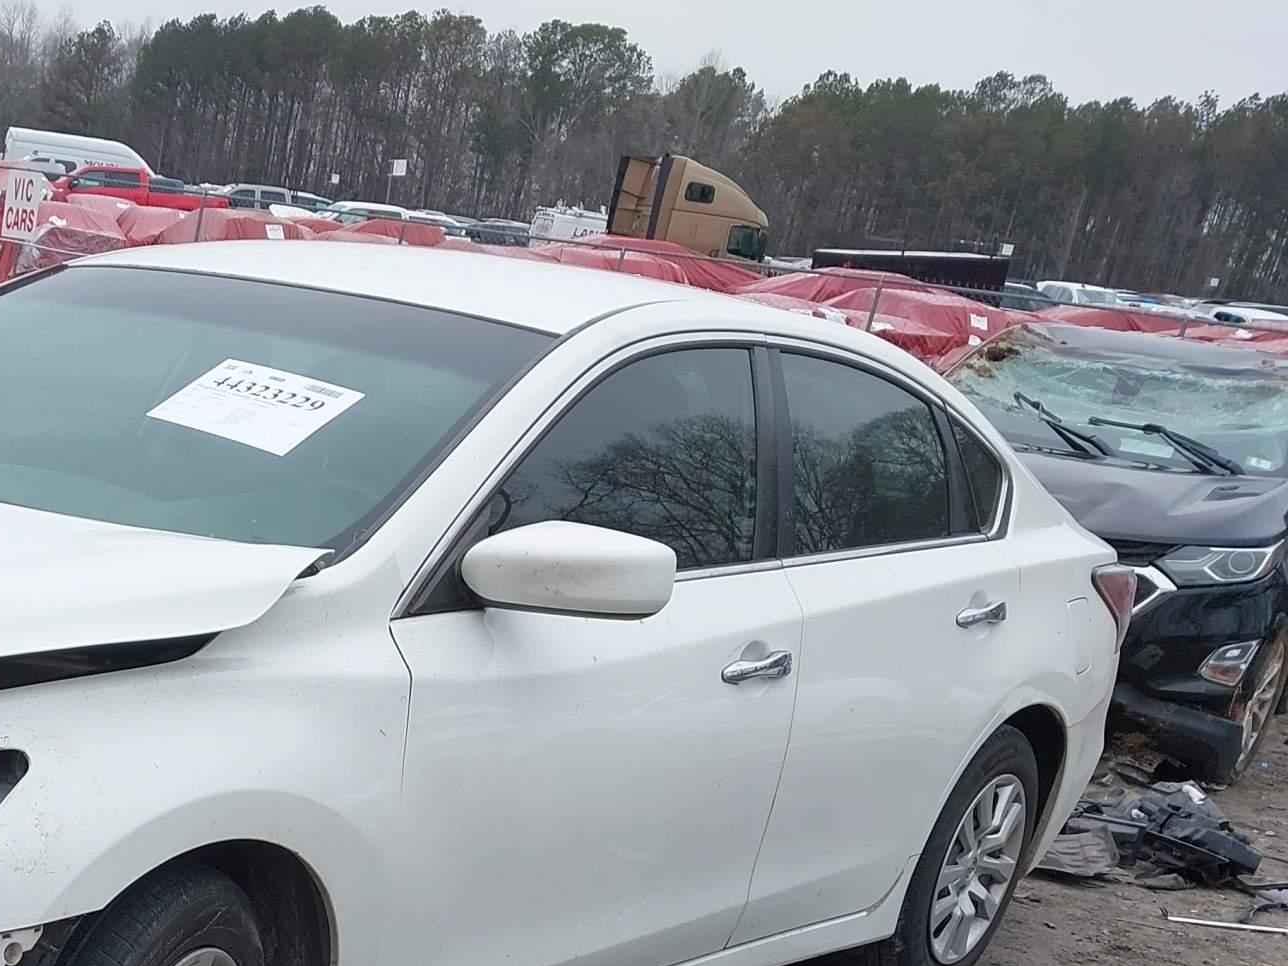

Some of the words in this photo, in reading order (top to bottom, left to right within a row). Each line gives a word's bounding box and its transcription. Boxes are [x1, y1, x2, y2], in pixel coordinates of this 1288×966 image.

[14, 177, 35, 202] VIC
[5, 206, 35, 233] CARS
[212, 376, 326, 411] 44323229
